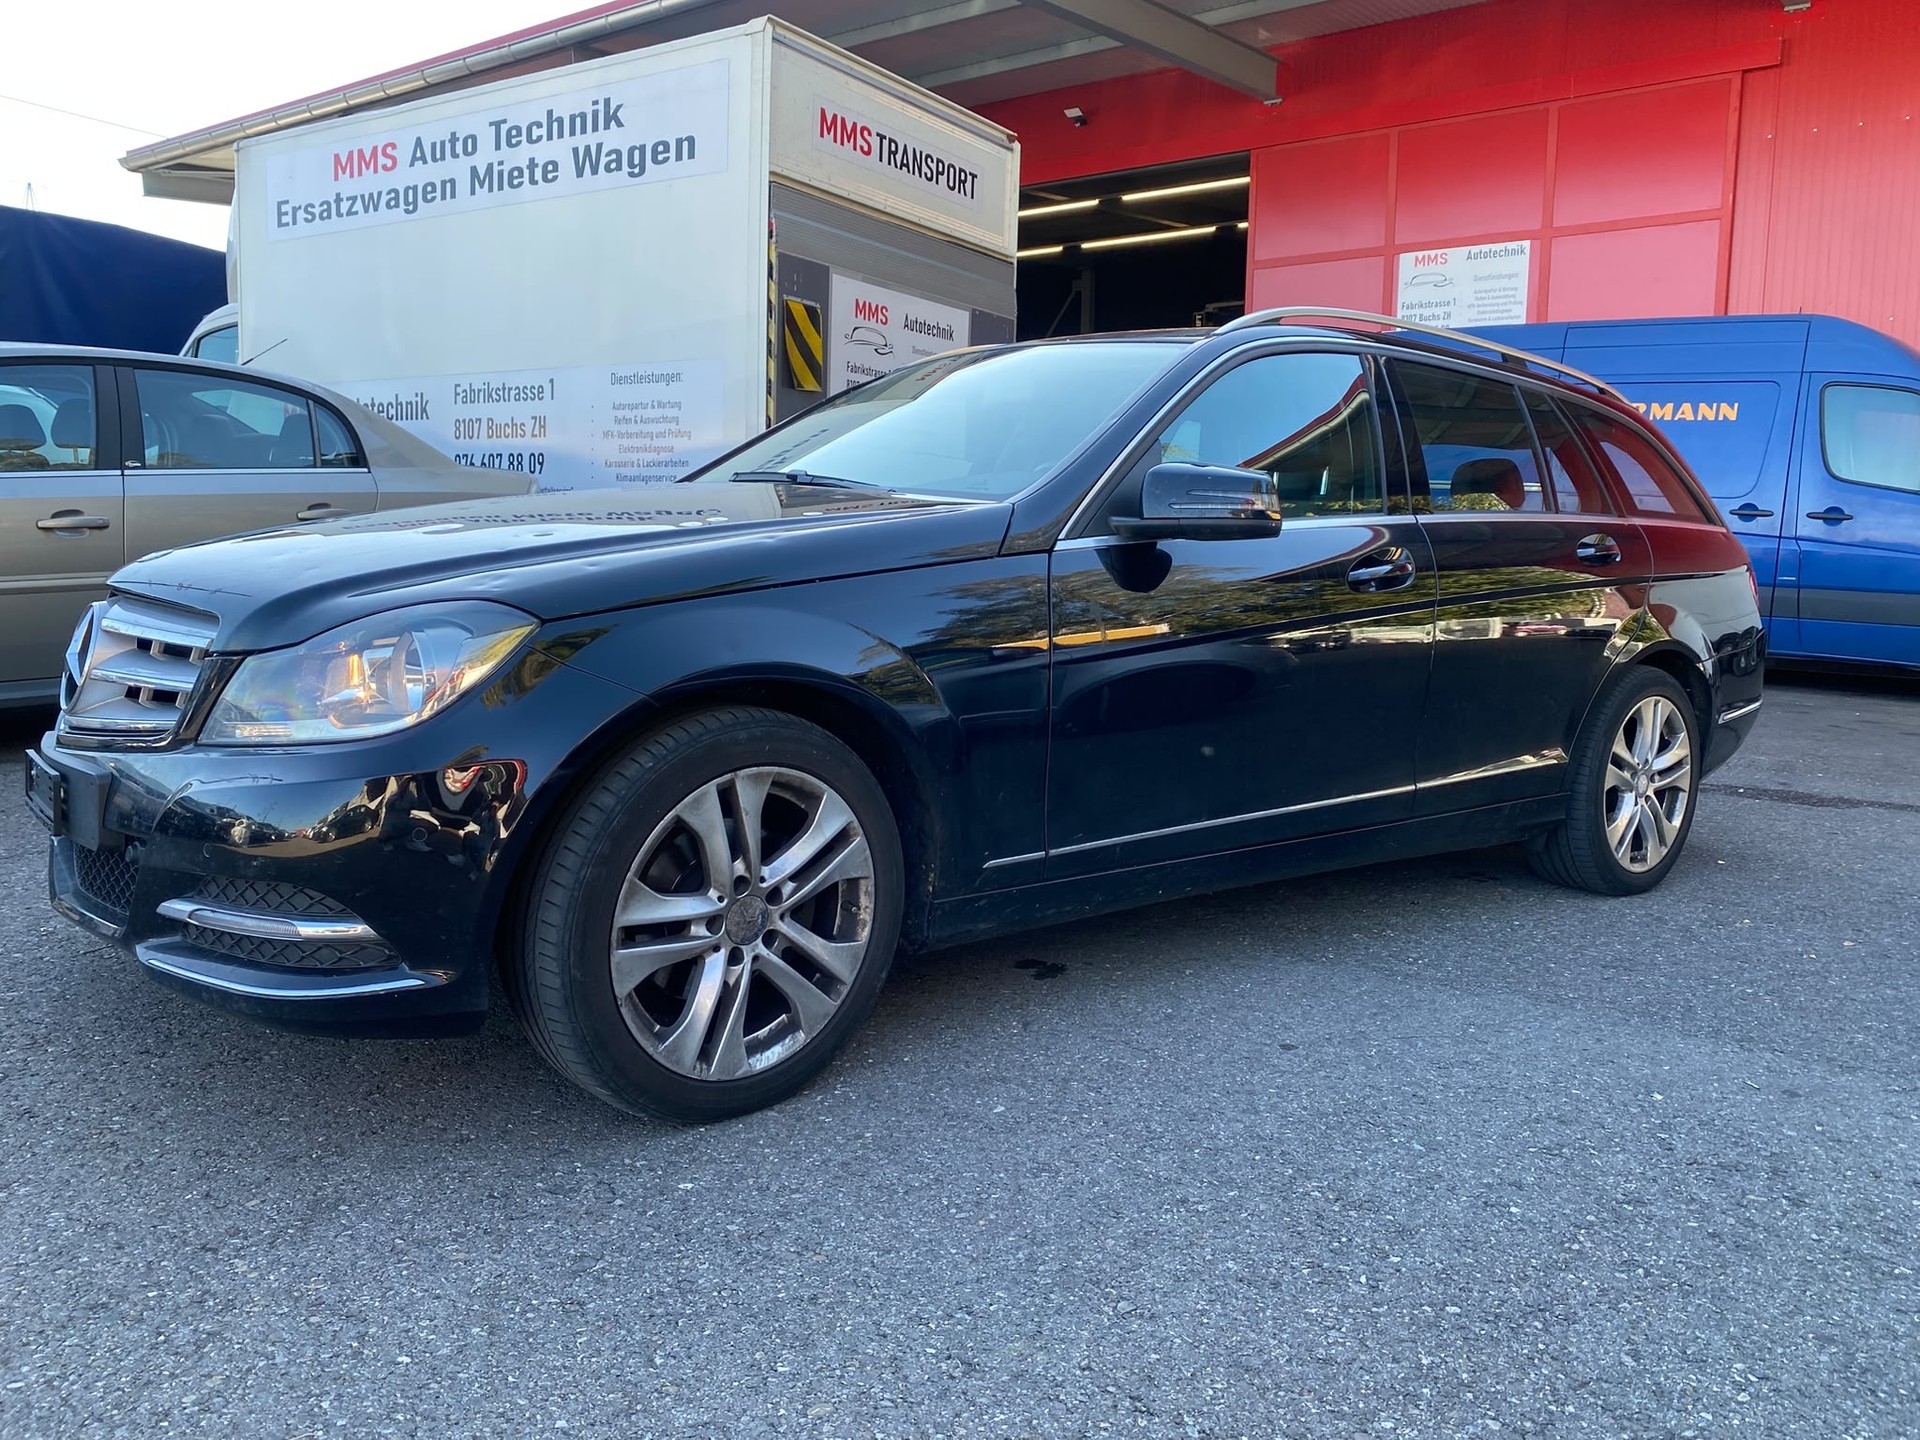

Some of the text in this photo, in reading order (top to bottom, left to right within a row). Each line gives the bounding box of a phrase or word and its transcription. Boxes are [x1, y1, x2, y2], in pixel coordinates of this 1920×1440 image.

[332, 97, 624, 182] MMS Auto Technik
[819, 106, 978, 200] MMS TRANSPORT
[276, 134, 696, 228] Ersatzwagen Miete Wagen
[1414, 244, 1526, 267] MMS Autotechnik
[1401, 299, 1451, 311] Fabrikstrasse
[1452, 298, 1456, 306] 1
[1419, 312, 1441, 322] Buchs
[1442, 311, 1452, 320] ZH
[854, 298, 955, 342] MMS Autotechnik
[610, 371, 683, 386] Dienstleistungen:
[846, 379, 860, 389] 810
[454, 378, 555, 405] Fabrikstrasse 1
[356, 392, 430, 421] technik
[454, 415, 547, 440] 8107 Buchs ZH
[508, 453, 524, 472] 88
[528, 452, 545, 475] 09
